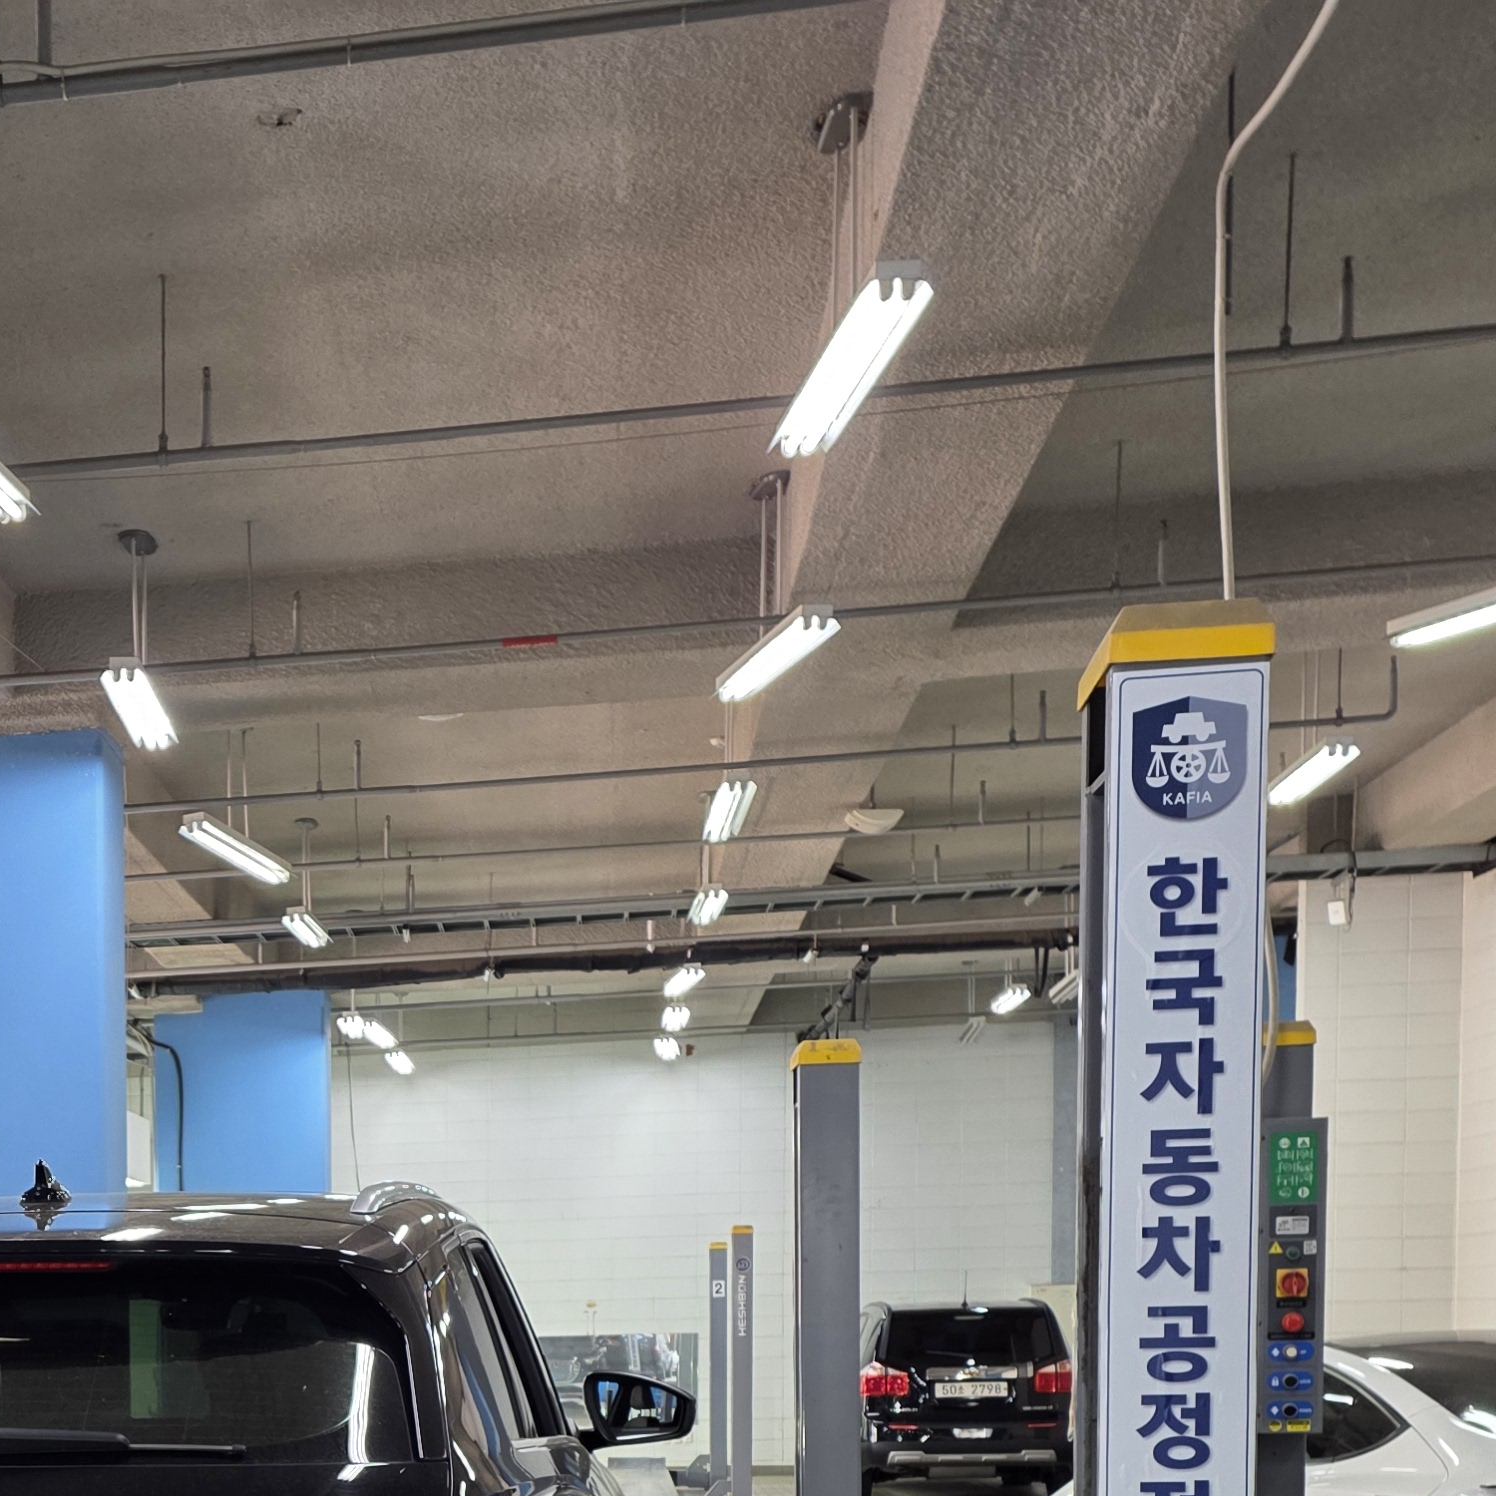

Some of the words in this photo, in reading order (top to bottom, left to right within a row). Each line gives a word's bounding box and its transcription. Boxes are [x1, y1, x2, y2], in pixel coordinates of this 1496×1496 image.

[1162, 790, 1213, 806] KAFIA
[714, 1282, 723, 1295] 2
[737, 1274, 747, 1336] HESHBON
[971, 1383, 1002, 1395] 2798
